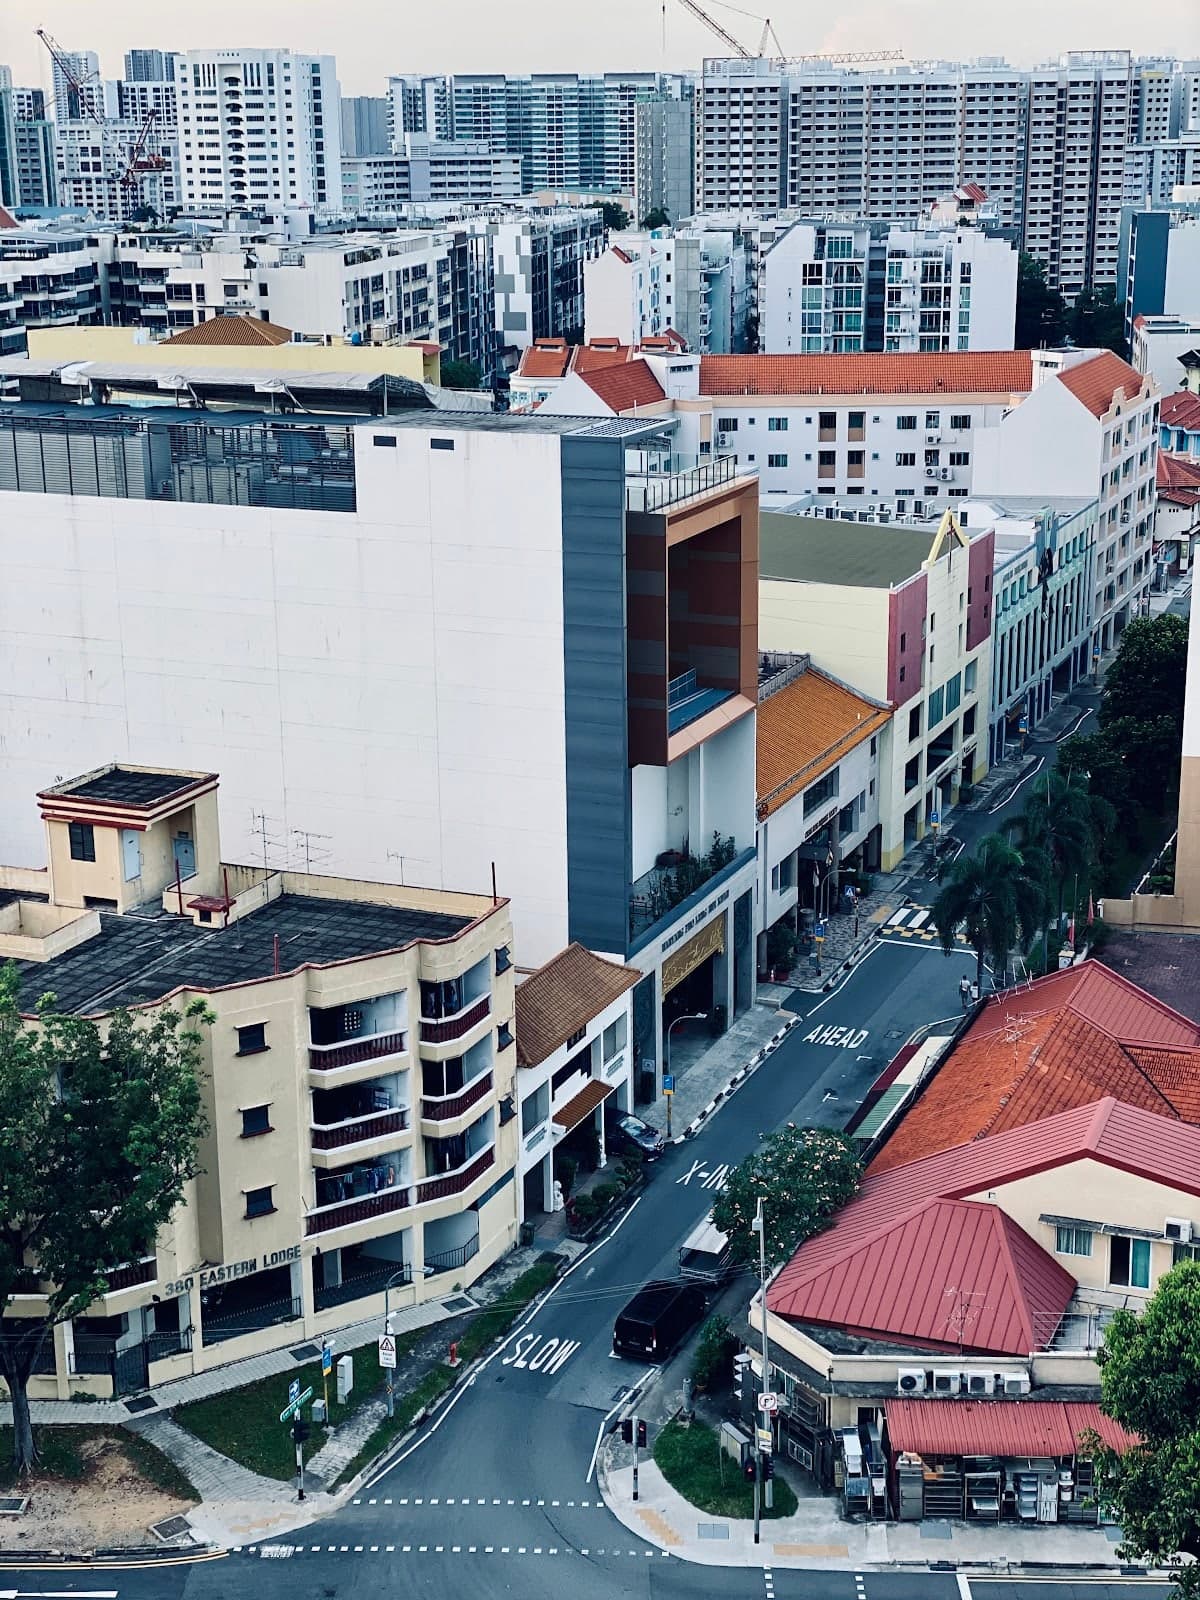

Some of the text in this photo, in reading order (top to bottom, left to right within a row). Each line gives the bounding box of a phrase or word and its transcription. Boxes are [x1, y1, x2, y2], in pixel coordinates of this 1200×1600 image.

[801, 1024, 869, 1049] AHEAD
[675, 1159, 738, 1191] X-IN
[164, 1244, 302, 1297] 380 EASTERN LODGE
[502, 1333, 582, 1375] SLOW
